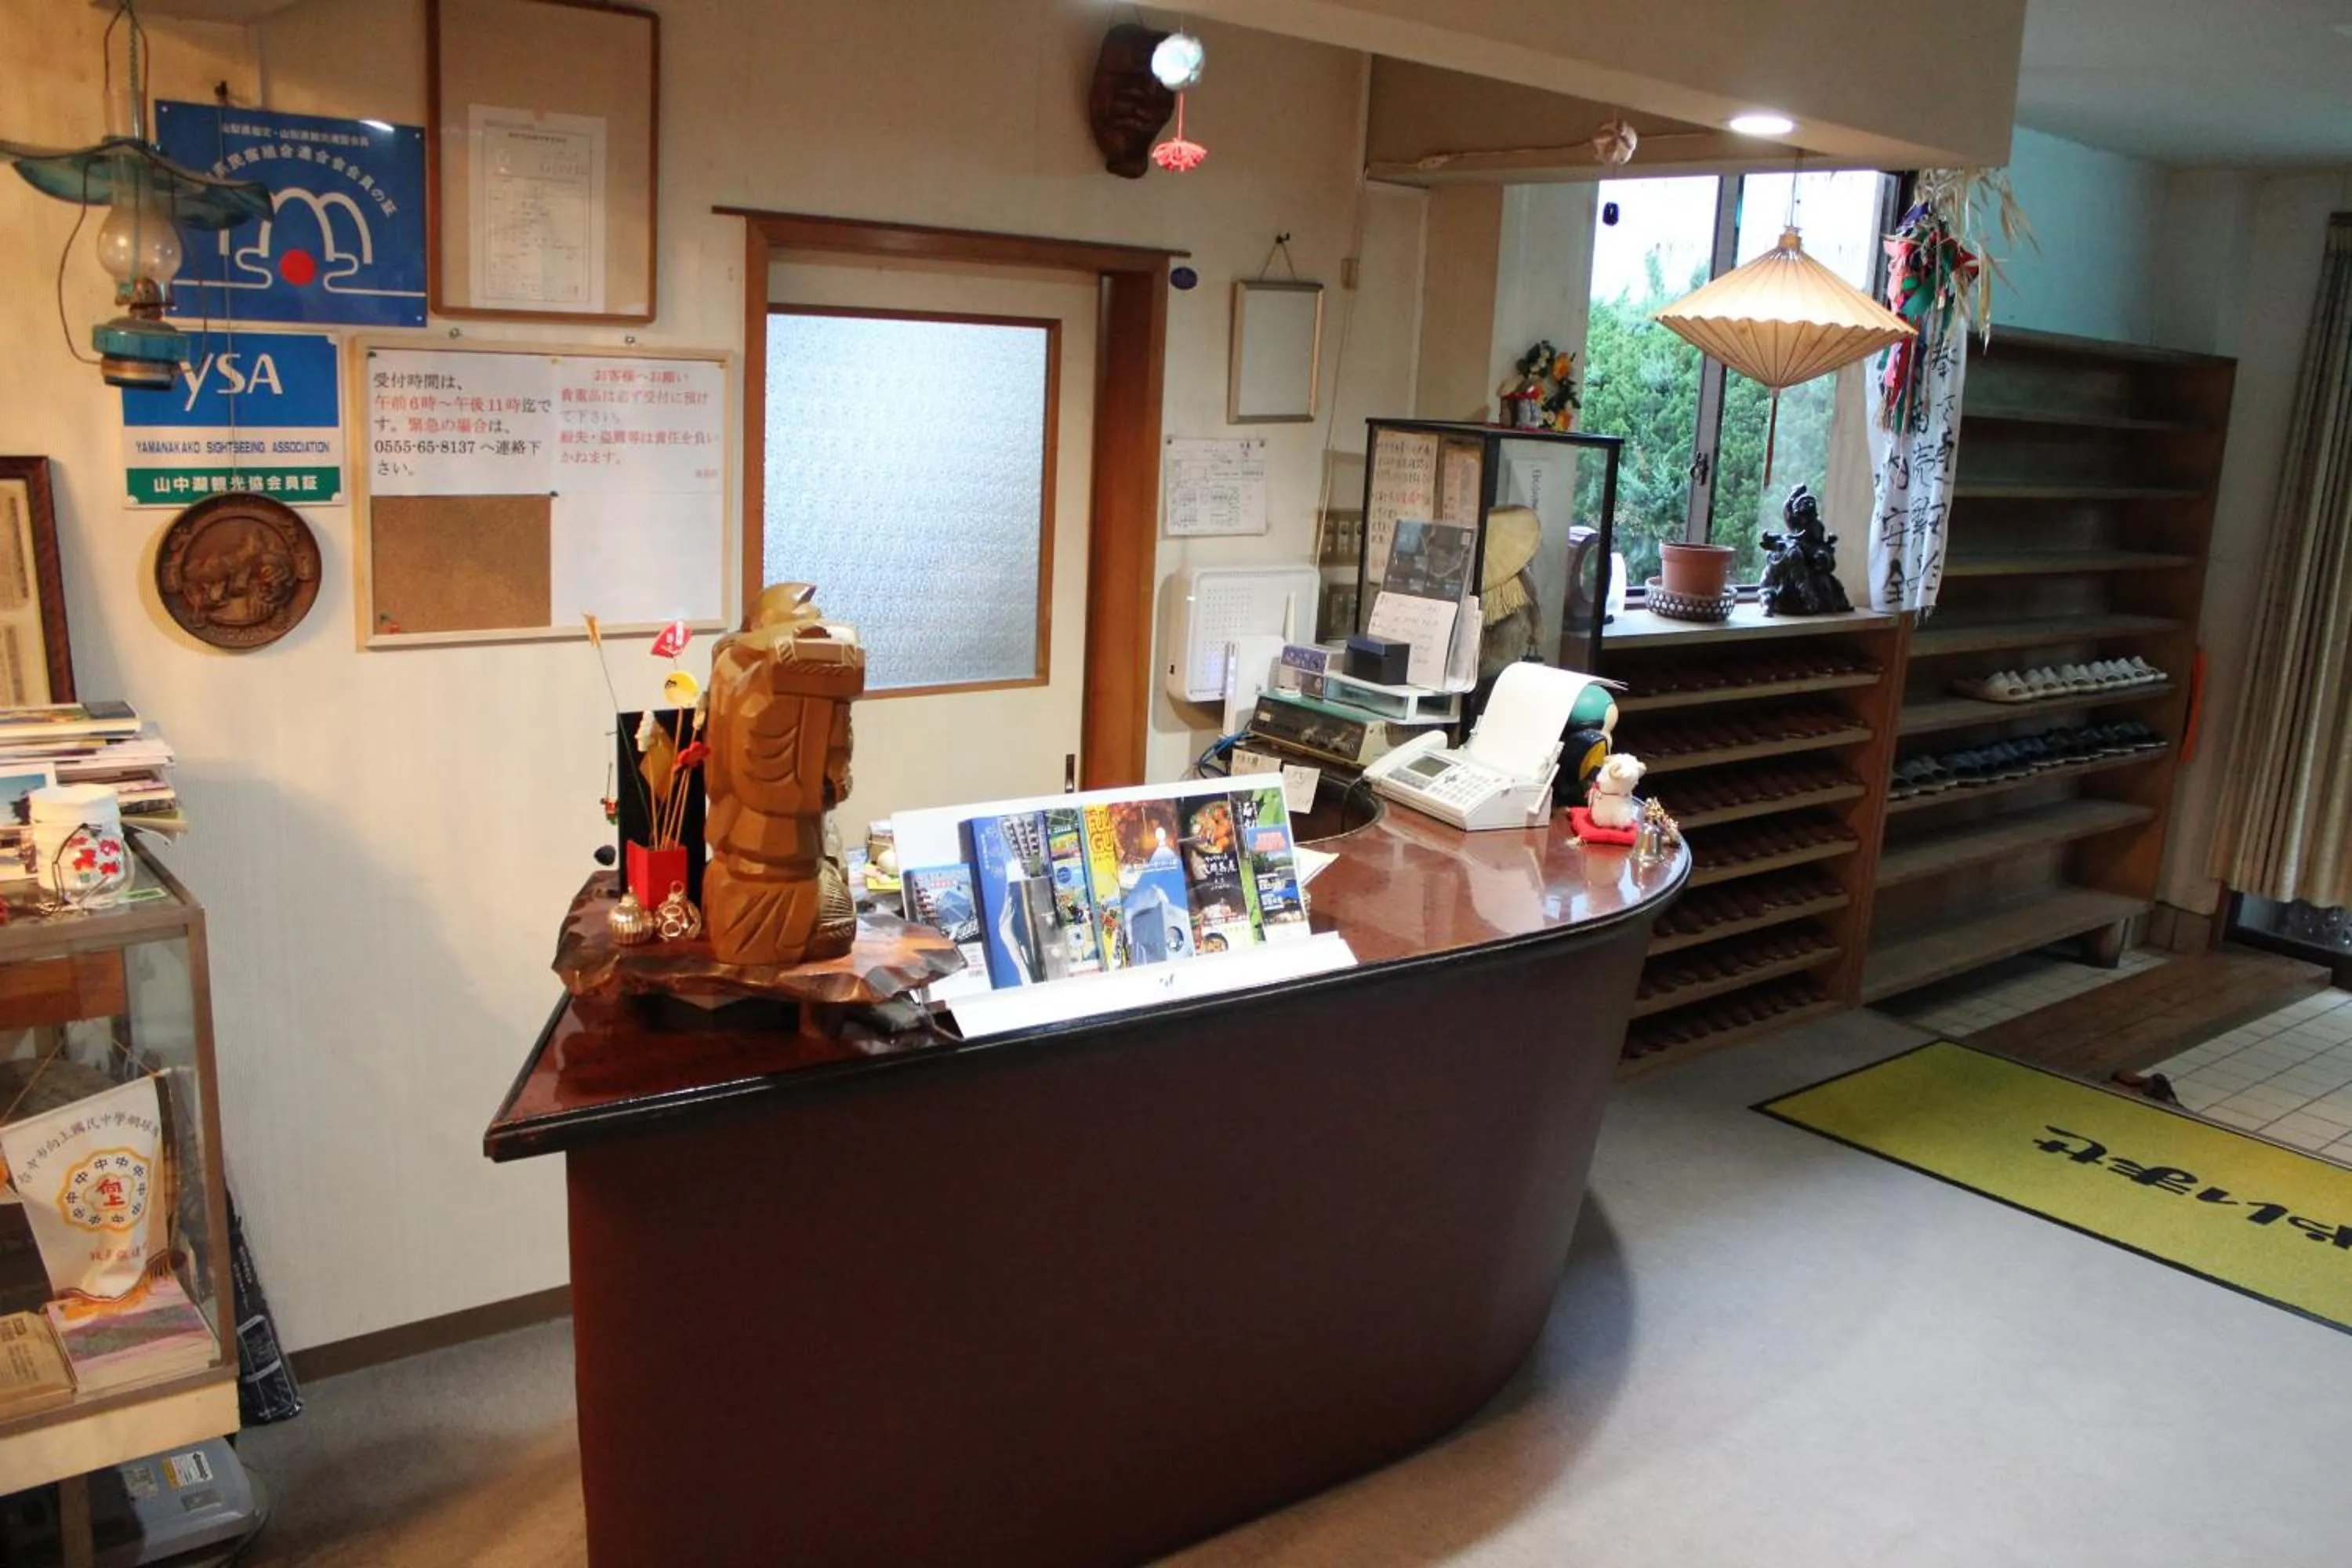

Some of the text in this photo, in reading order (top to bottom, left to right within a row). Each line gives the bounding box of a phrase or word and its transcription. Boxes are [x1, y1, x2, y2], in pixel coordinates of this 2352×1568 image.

[374, 372, 463, 390] 受付時間は、
[136, 441, 330, 453] YAMANAKAKO SIGHTSEEING ASSOCIATION
[377, 459, 416, 476] さい。
